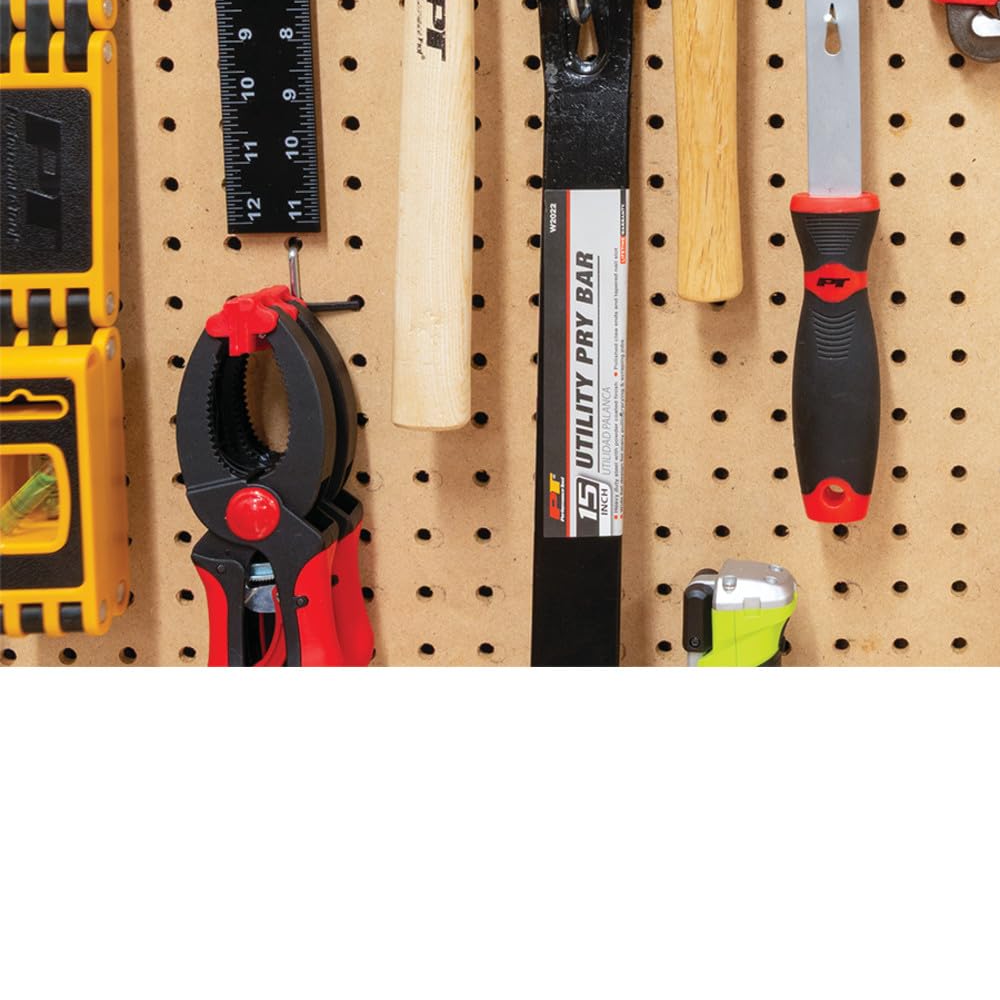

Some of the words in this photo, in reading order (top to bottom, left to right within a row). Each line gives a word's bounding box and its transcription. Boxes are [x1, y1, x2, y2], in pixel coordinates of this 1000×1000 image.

[238, 28, 252, 40] 9
[280, 28, 293, 39] 8
[241, 77, 255, 100] 10
[283, 89, 296, 100] 9
[244, 141, 257, 161] 11
[285, 136, 299, 159] 10
[247, 198, 261, 221] 12
[288, 200, 302, 219] 11
[549, 203, 557, 233] W2022
[576, 251, 593, 305] BAR
[817, 278, 850, 287] PT
[576, 311, 593, 365] PRY
[576, 371, 593, 469] UTILITY
[602, 387, 611, 430] PALANCA
[602, 431, 611, 475] UTILIDAD
[549, 472, 560, 520] PT
[578, 482, 598, 520] 15
